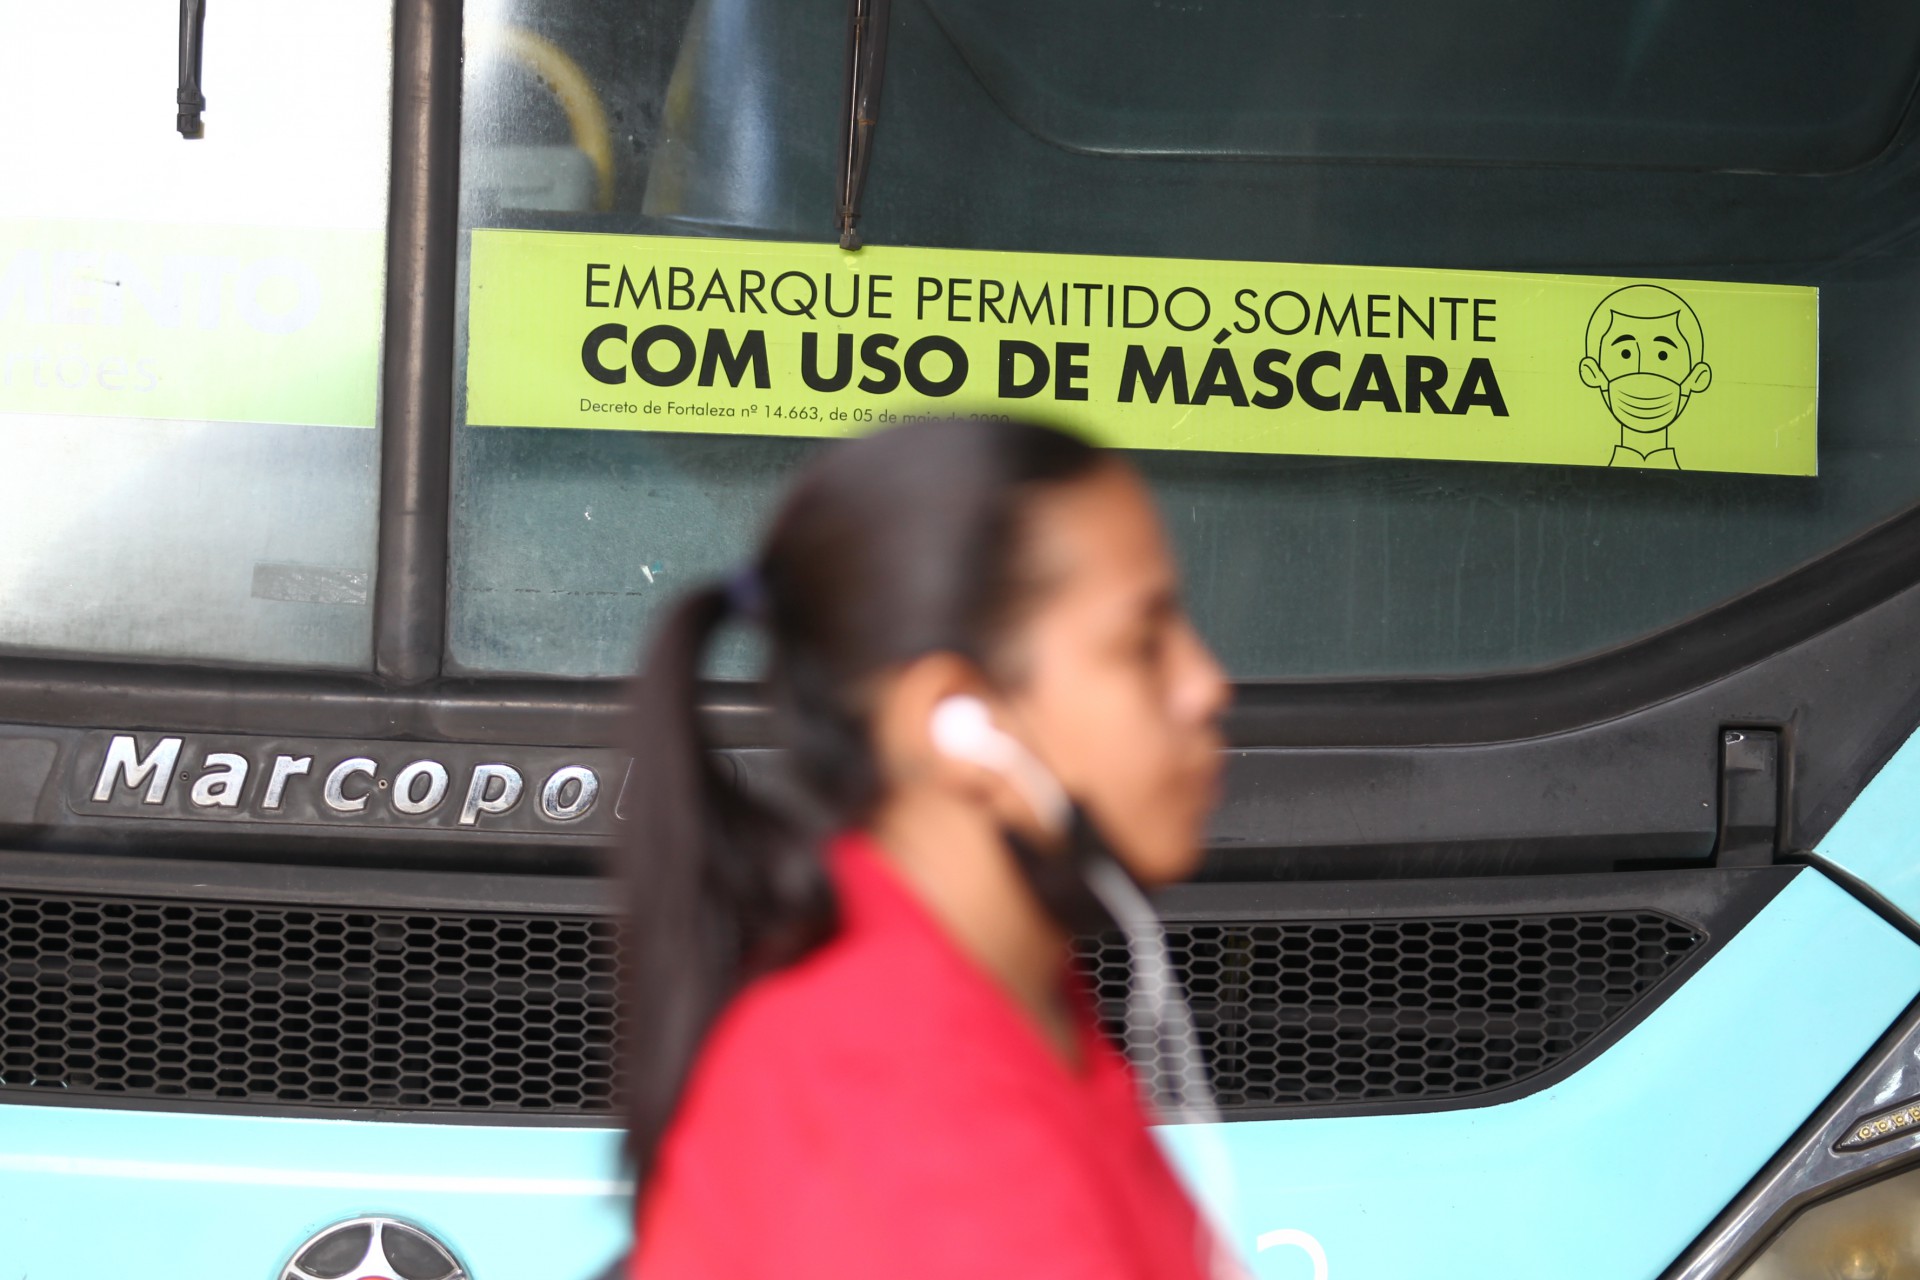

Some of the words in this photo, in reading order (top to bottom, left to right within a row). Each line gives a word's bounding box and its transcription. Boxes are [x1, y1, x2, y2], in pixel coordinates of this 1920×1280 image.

[585, 263, 893, 319] EMBARQUE
[917, 276, 1211, 332] PERMITIDO
[1233, 288, 1497, 343] SOMENTE
[580, 398, 638, 414] Decreto
[643, 400, 662, 414] de
[667, 401, 735, 417] Fortaleza
[741, 404, 758, 418] nº
[764, 404, 824, 422] 14.663,
[828, 407, 848, 421] de
[853, 408, 873, 422] 05
[878, 408, 897, 424] de
[581, 323, 771, 389] COM
[801, 331, 969, 398] USO
[998, 339, 1090, 402] DE
[1117, 327, 1510, 417] MÁSCARA
[93, 735, 632, 825] Marcopo
